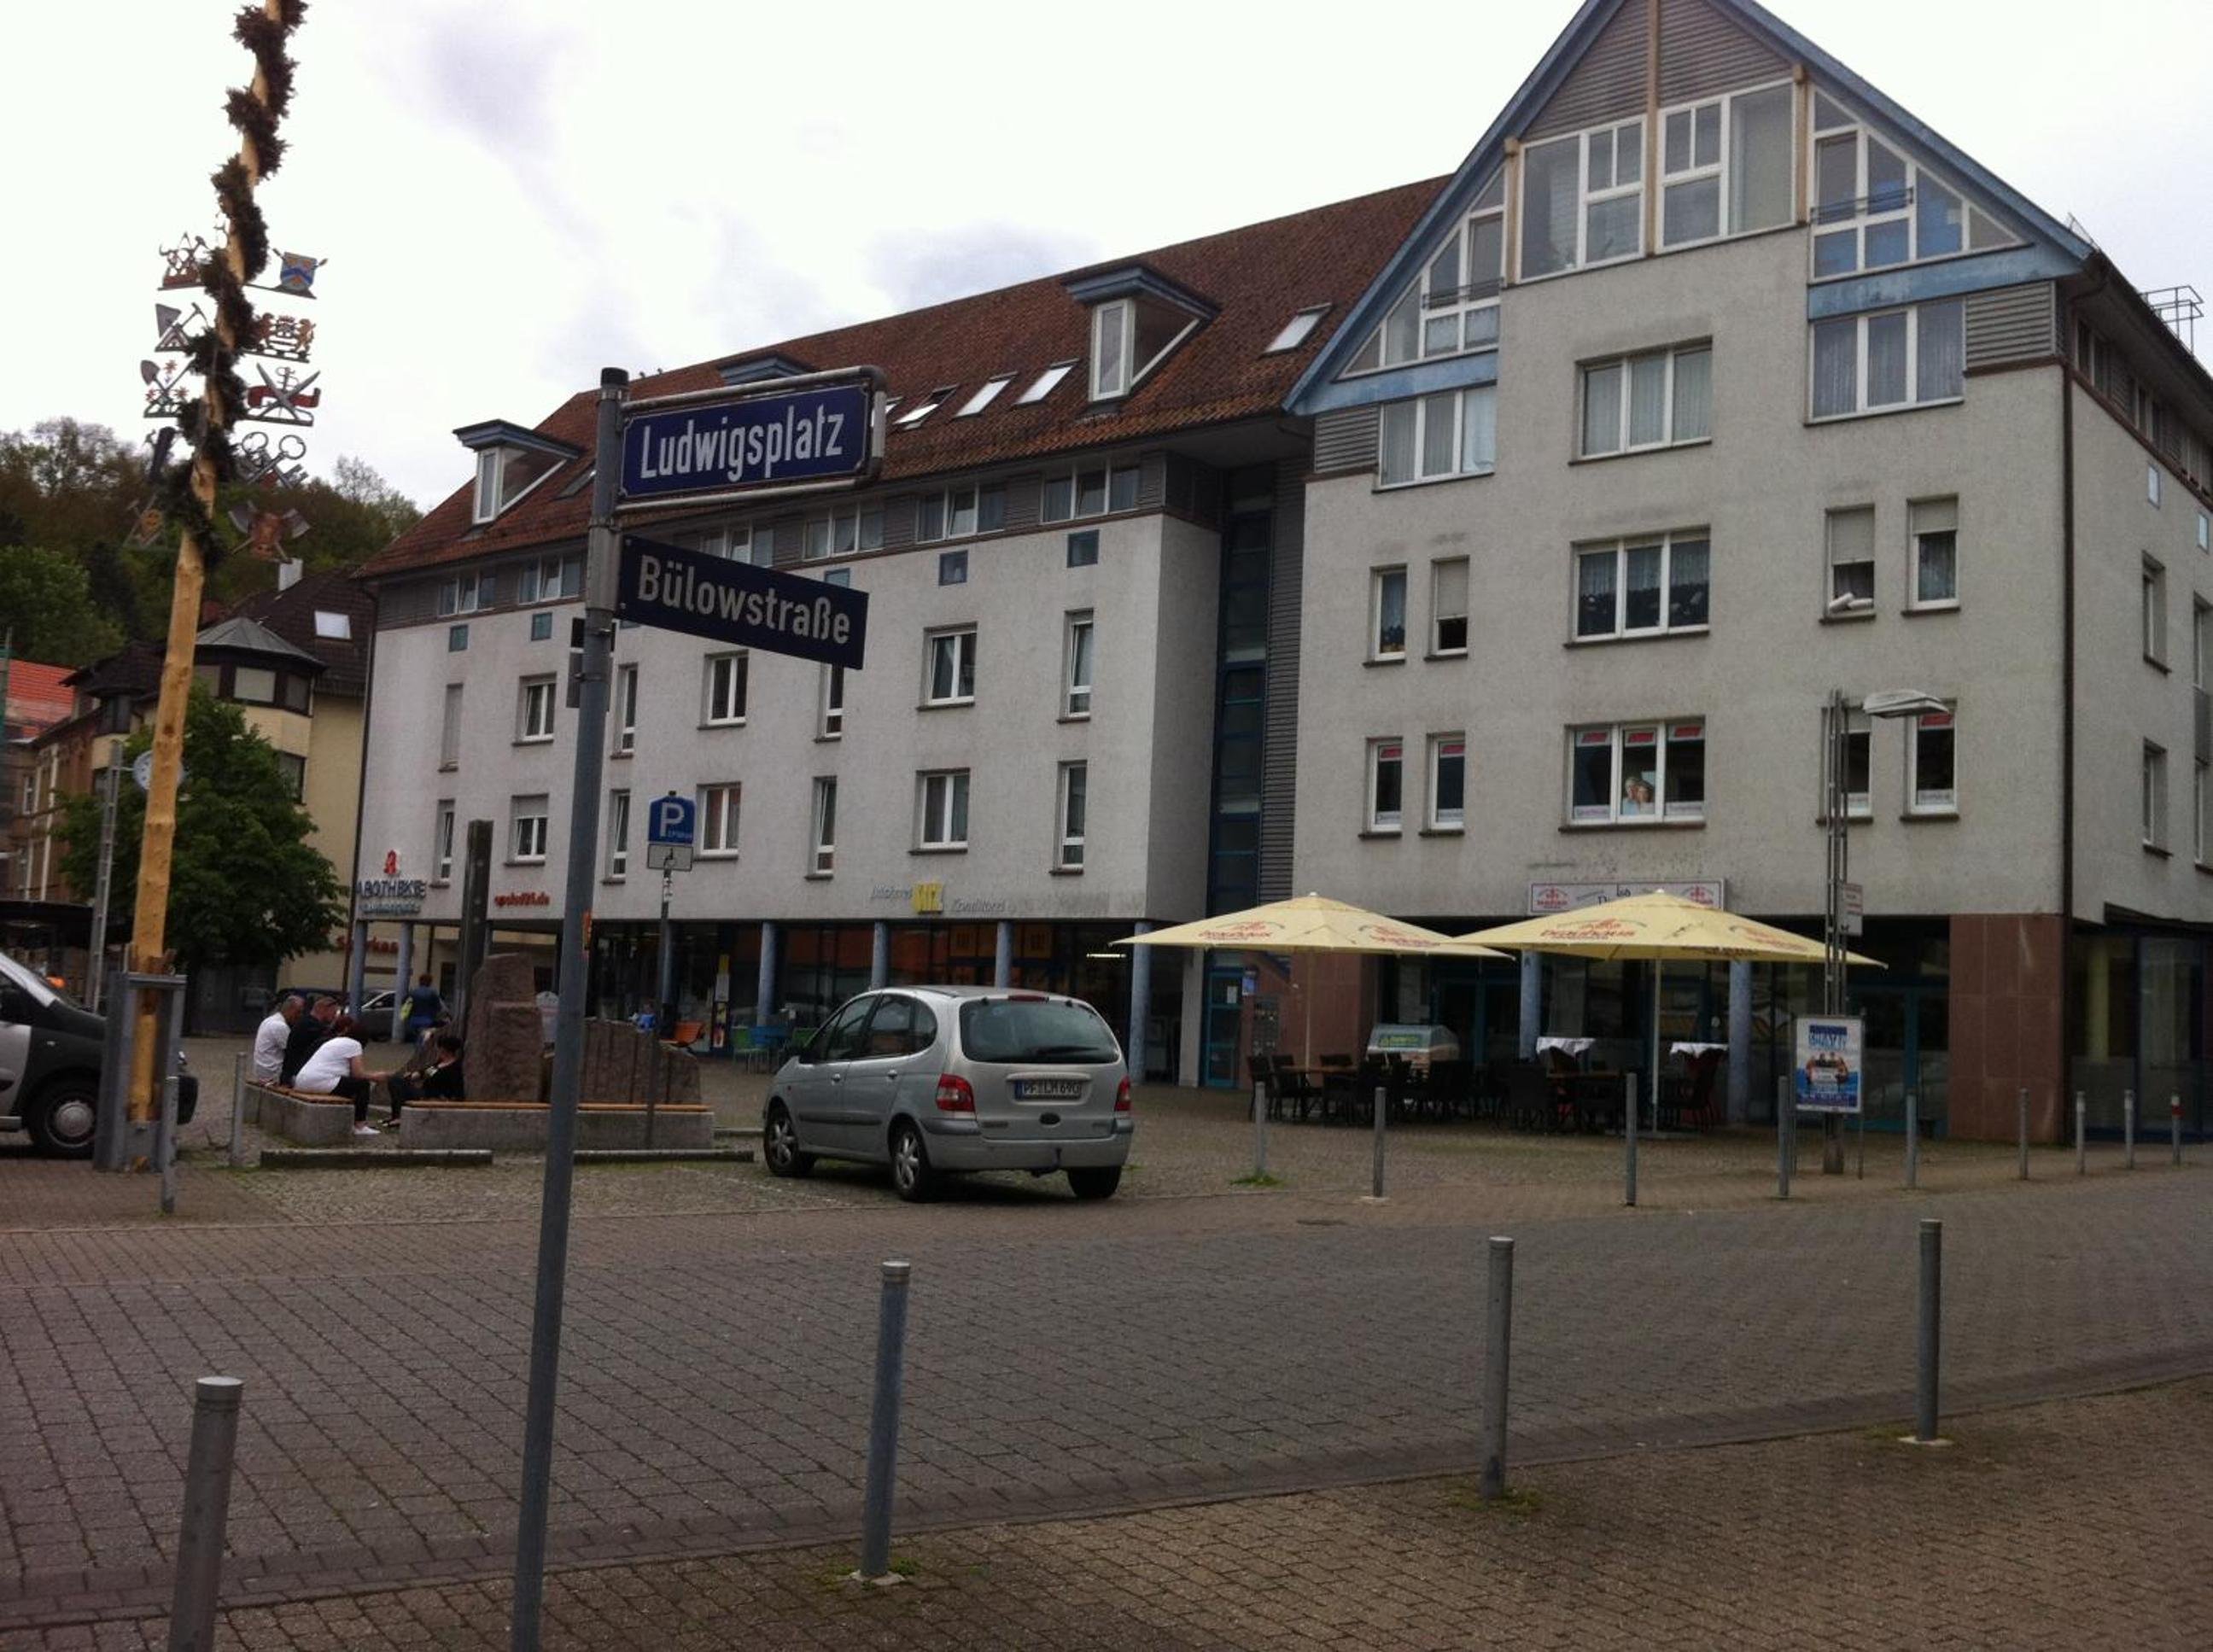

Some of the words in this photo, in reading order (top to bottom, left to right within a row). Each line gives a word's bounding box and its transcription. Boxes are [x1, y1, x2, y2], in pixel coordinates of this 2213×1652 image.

[639, 404, 844, 482] Ludwigsplatz
[636, 553, 850, 644] Bülowstraße
[659, 802, 685, 838] P
